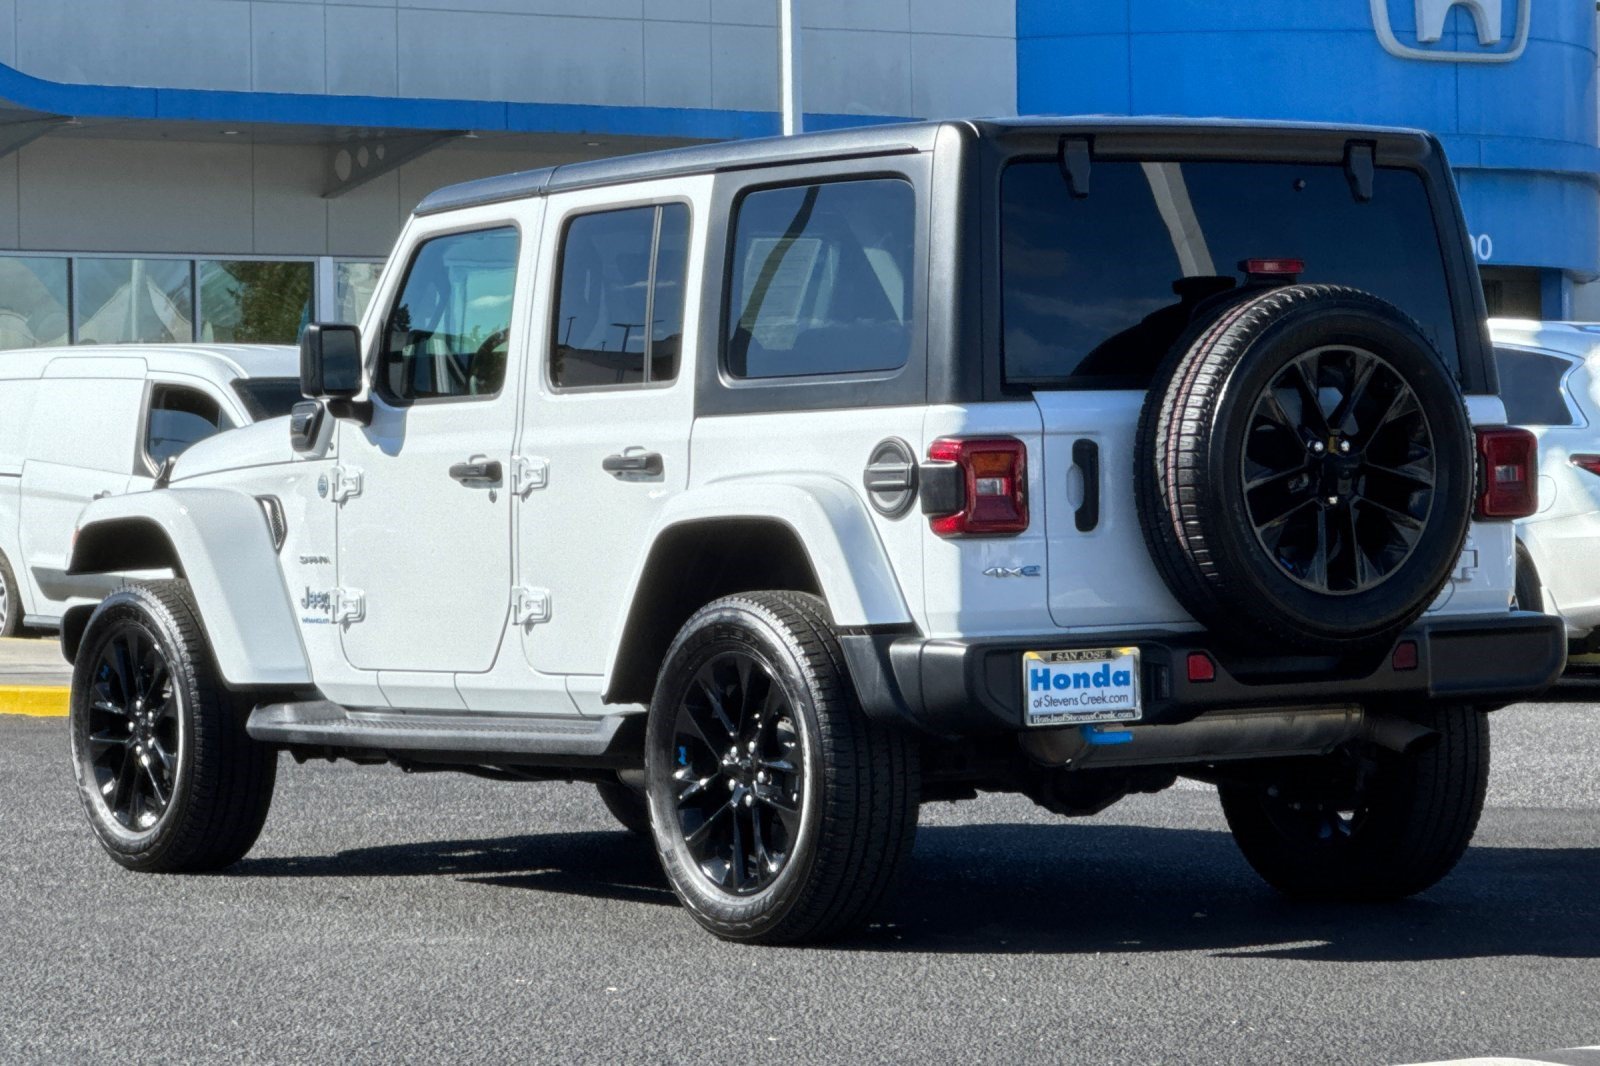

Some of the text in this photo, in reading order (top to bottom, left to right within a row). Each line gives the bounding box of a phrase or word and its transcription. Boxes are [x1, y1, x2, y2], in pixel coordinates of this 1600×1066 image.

[301, 586, 330, 614] Jeep
[1056, 650, 1107, 661] SAN JOSE
[1030, 663, 1131, 692] Honda
[1033, 690, 1129, 708] of Stevens Creek.com
